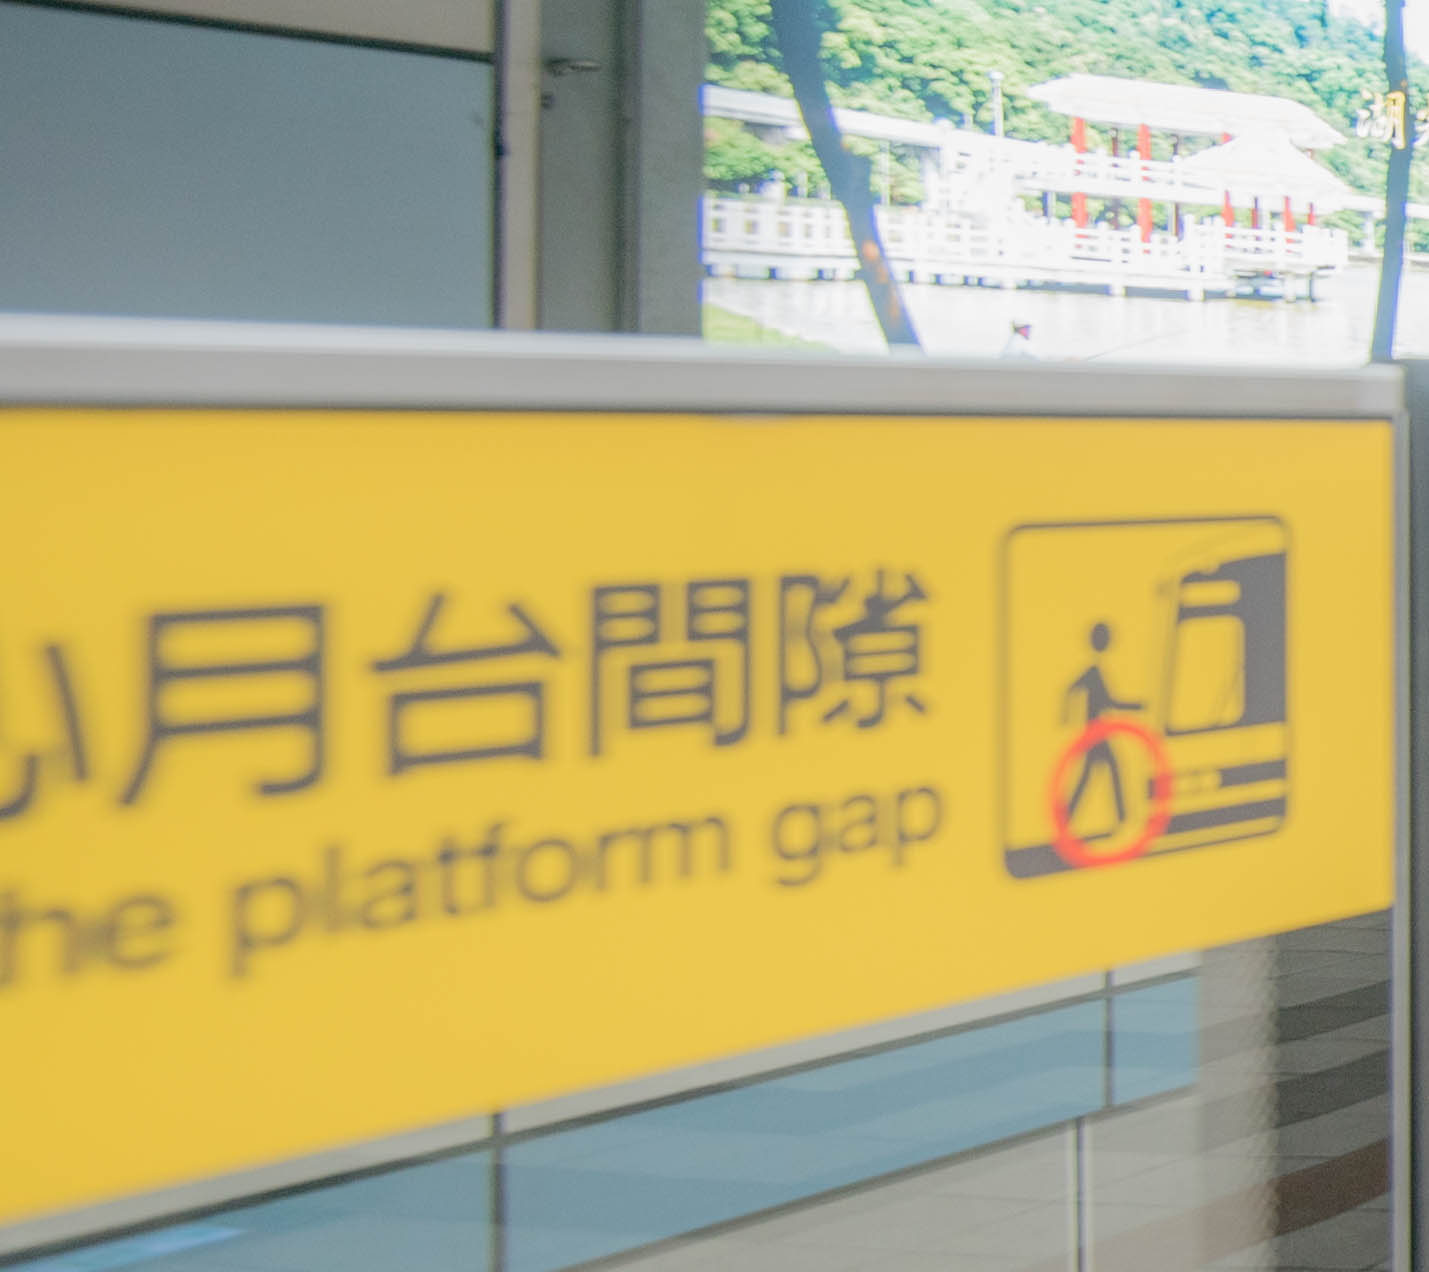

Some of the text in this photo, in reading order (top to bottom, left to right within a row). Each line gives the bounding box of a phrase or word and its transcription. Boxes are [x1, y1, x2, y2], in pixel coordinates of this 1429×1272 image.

[0, 780, 946, 986] he platform gap
